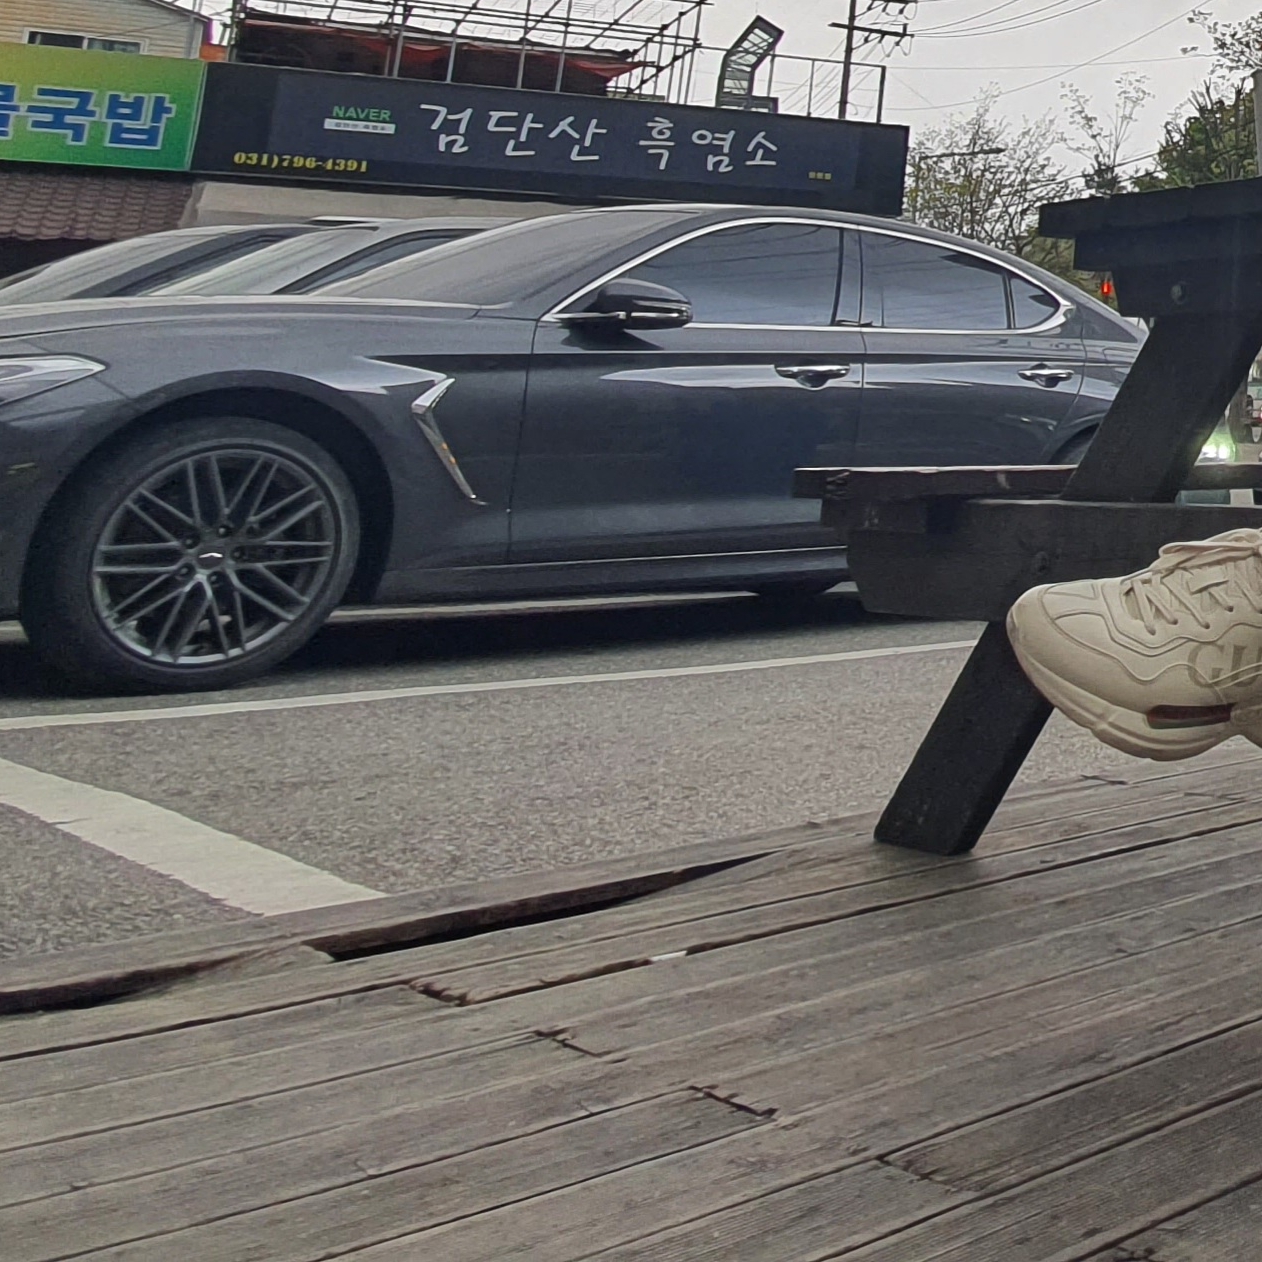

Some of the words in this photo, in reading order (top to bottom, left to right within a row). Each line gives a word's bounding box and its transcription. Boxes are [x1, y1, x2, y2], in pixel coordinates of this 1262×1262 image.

[332, 105, 392, 122] NAVER
[419, 103, 608, 162] 검단산
[638, 116, 778, 173] 흑염소
[233, 151, 368, 173] 031)796-4391
